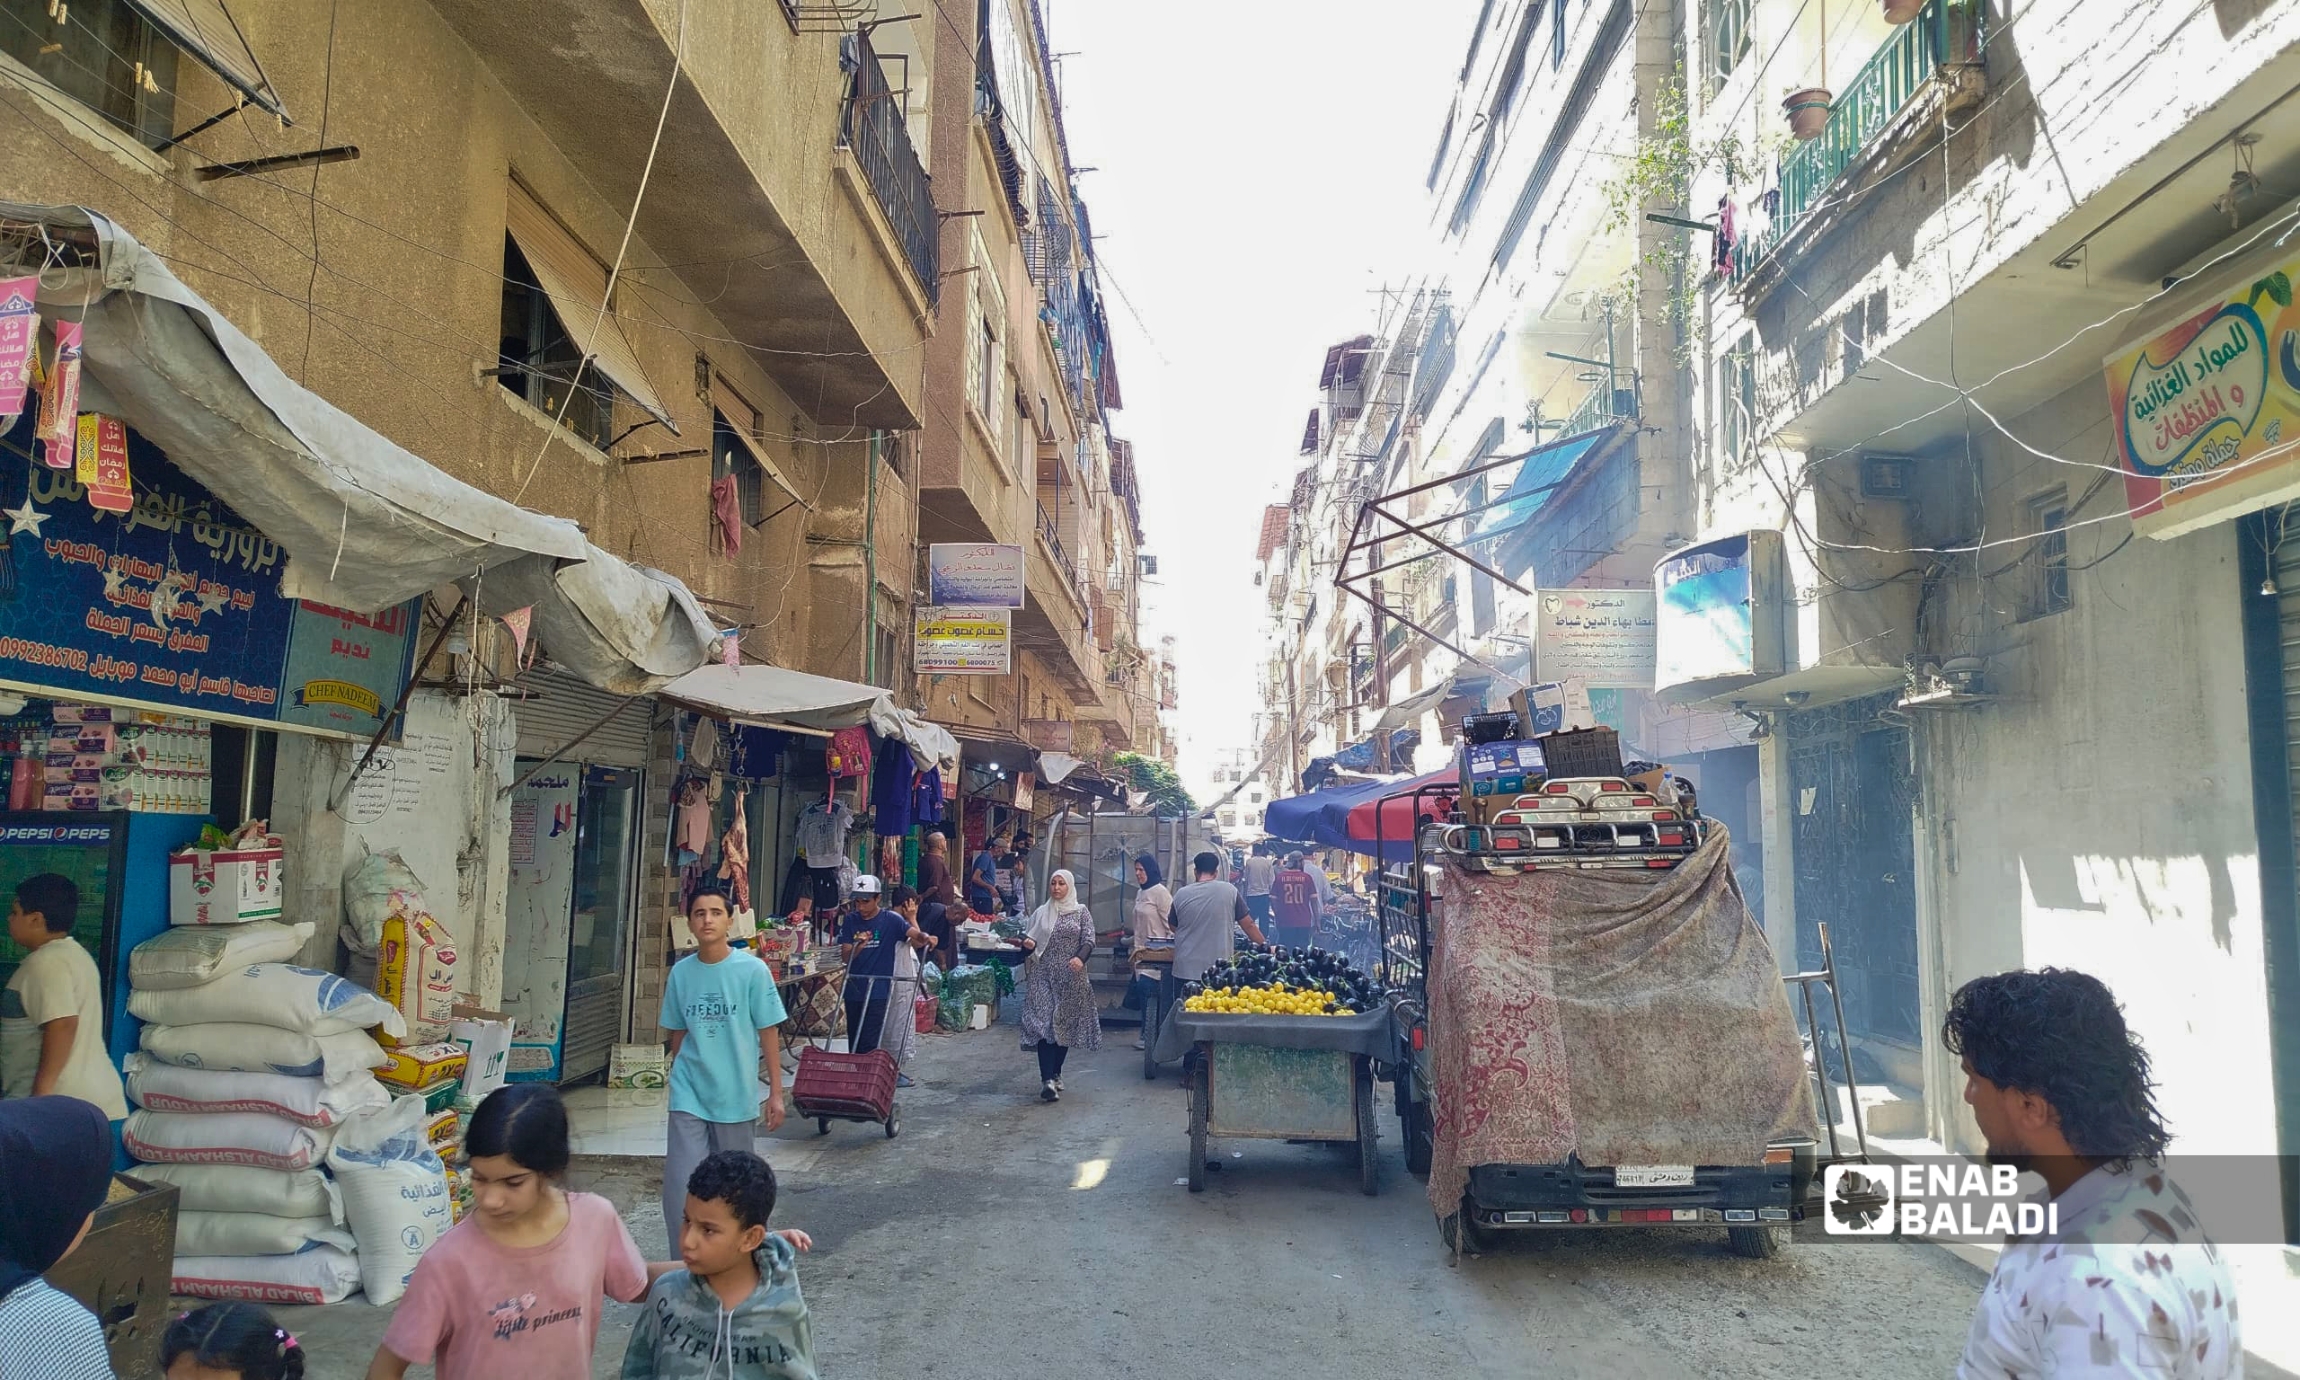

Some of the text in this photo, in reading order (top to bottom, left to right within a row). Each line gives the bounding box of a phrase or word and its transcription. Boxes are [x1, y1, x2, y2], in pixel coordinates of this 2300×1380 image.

[2193, 320, 2249, 382] للمواد
[2131, 360, 2192, 422] الغذائية
[2230, 384, 2245, 408] و
[2155, 384, 2227, 450] المنظفات
[99, 457, 126, 469] رمضان
[2168, 435, 2241, 493] جملة ومفرق
[45, 538, 106, 571] والحبوب
[1586, 599, 1625, 610] الدكتور
[86, 607, 209, 653] المفرق بسعر الجملة
[976, 626, 1004, 638] حسام
[1555, 615, 1581, 629] شباط
[1583, 616, 1611, 629] الدين
[0, 637, 88, 671] 0992386702
[330, 637, 370, 660] نديم
[89, 654, 137, 683] موبايل
[141, 664, 177, 686] محمد
[199, 677, 232, 698] قاسم
[308, 684, 378, 710] CHEF NADEEM
[6, 828, 111, 841] PEPSI PEPS
[1284, 883, 1304, 904] 20
[149, 1096, 198, 1112] FLOUR
[131, 1145, 302, 1167] BILAD ALSHAAM FLOU
[181, 1281, 264, 1300] ALSHAAM
[267, 1288, 316, 1303] BILAD
[657, 1297, 792, 1364] CALIFORNIA
